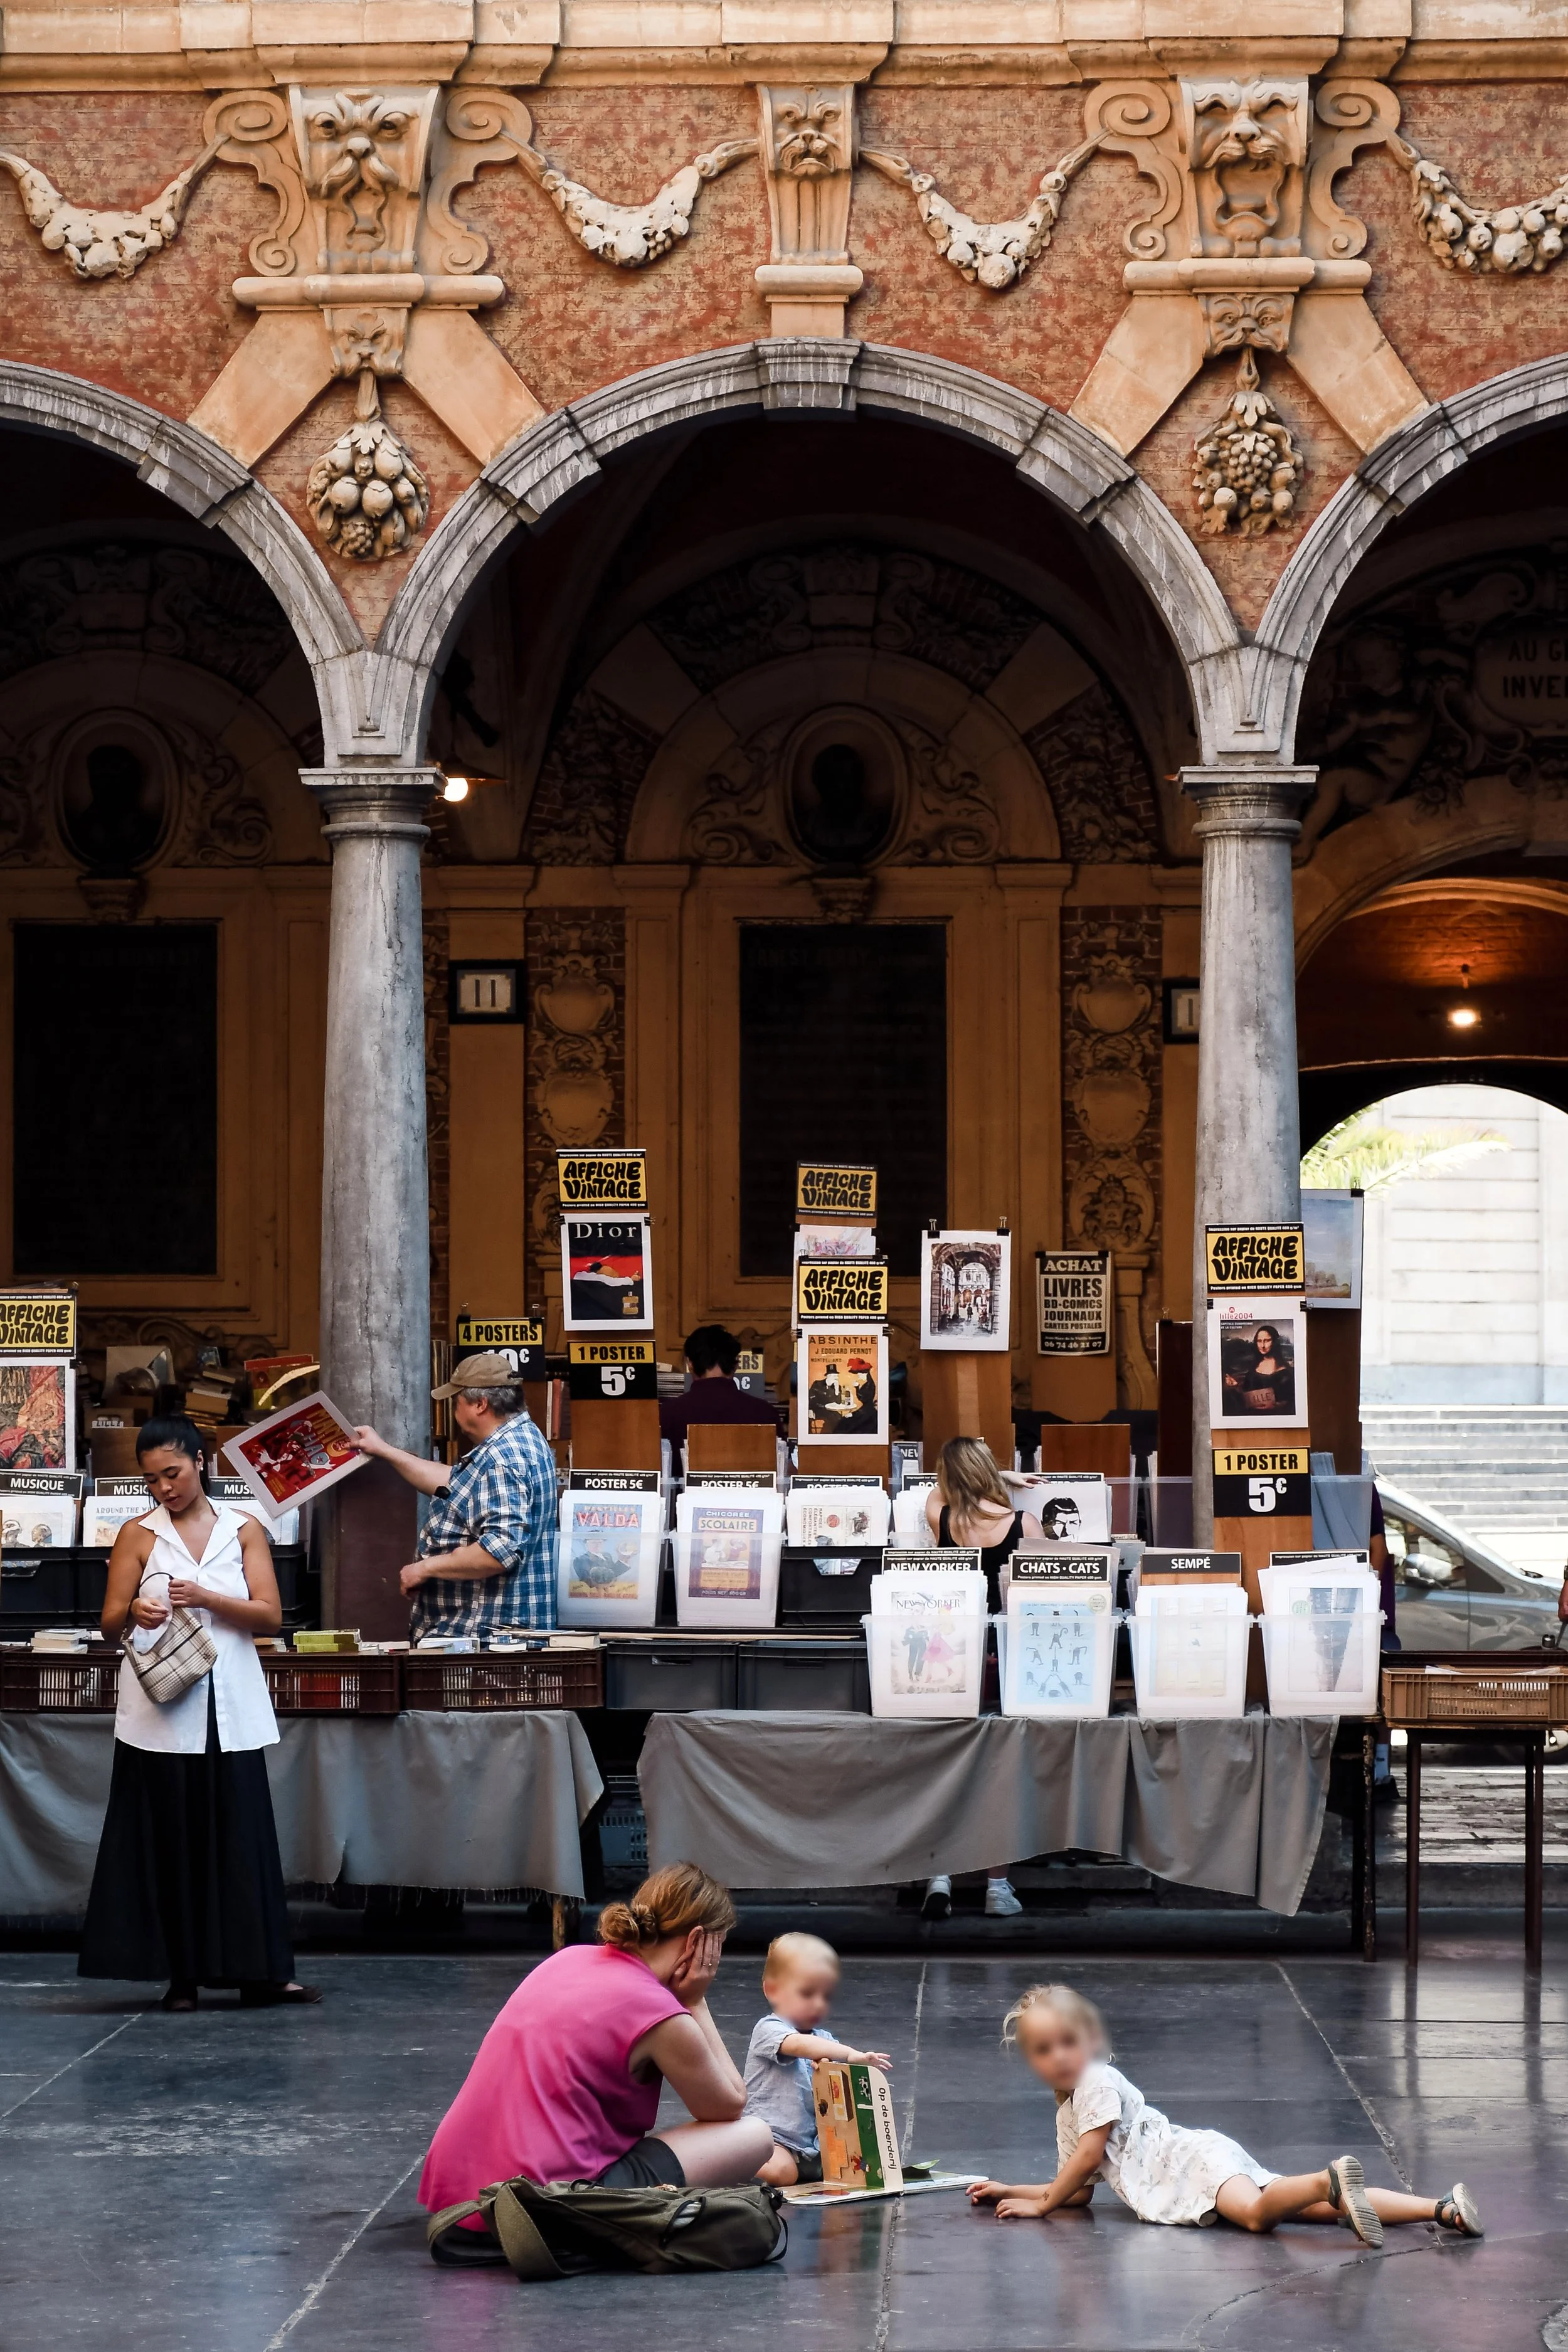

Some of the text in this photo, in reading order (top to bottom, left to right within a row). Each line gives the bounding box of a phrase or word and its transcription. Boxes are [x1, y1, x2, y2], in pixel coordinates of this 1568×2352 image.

[1549, 639, 1568, 661] G
[1503, 676, 1568, 697] INVE
[563, 1161, 641, 1182] AFFICHE
[803, 1170, 873, 1191] AFFICHE
[575, 1223, 636, 1238] Dior
[1213, 1236, 1298, 1260] AFFICHE
[1044, 1260, 1102, 1271] ACHAT
[805, 1269, 884, 1291] AFFICHE
[1044, 1278, 1102, 1297] LIVRES
[1044, 1299, 1102, 1308] BD-COMICS
[1044, 1311, 1101, 1321] JOURNAUX
[463, 1325, 538, 1342] 4 POSTERS
[578, 1346, 645, 1360] 1 POSTER
[1224, 1454, 1298, 1470] 1 POSTER
[10, 1478, 64, 1491] MUSIQUE
[585, 1478, 643, 1489] POSTER 5€
[576, 1512, 639, 1528] VALDA
[701, 1520, 754, 1530] SCOLAIRE
[922, 1563, 971, 1571] YORKER
[1020, 1562, 1099, 1574] CHATS CATS
[1171, 1556, 1210, 1569] SEMPÉ
[878, 2088, 897, 2169] Op de boerderij
